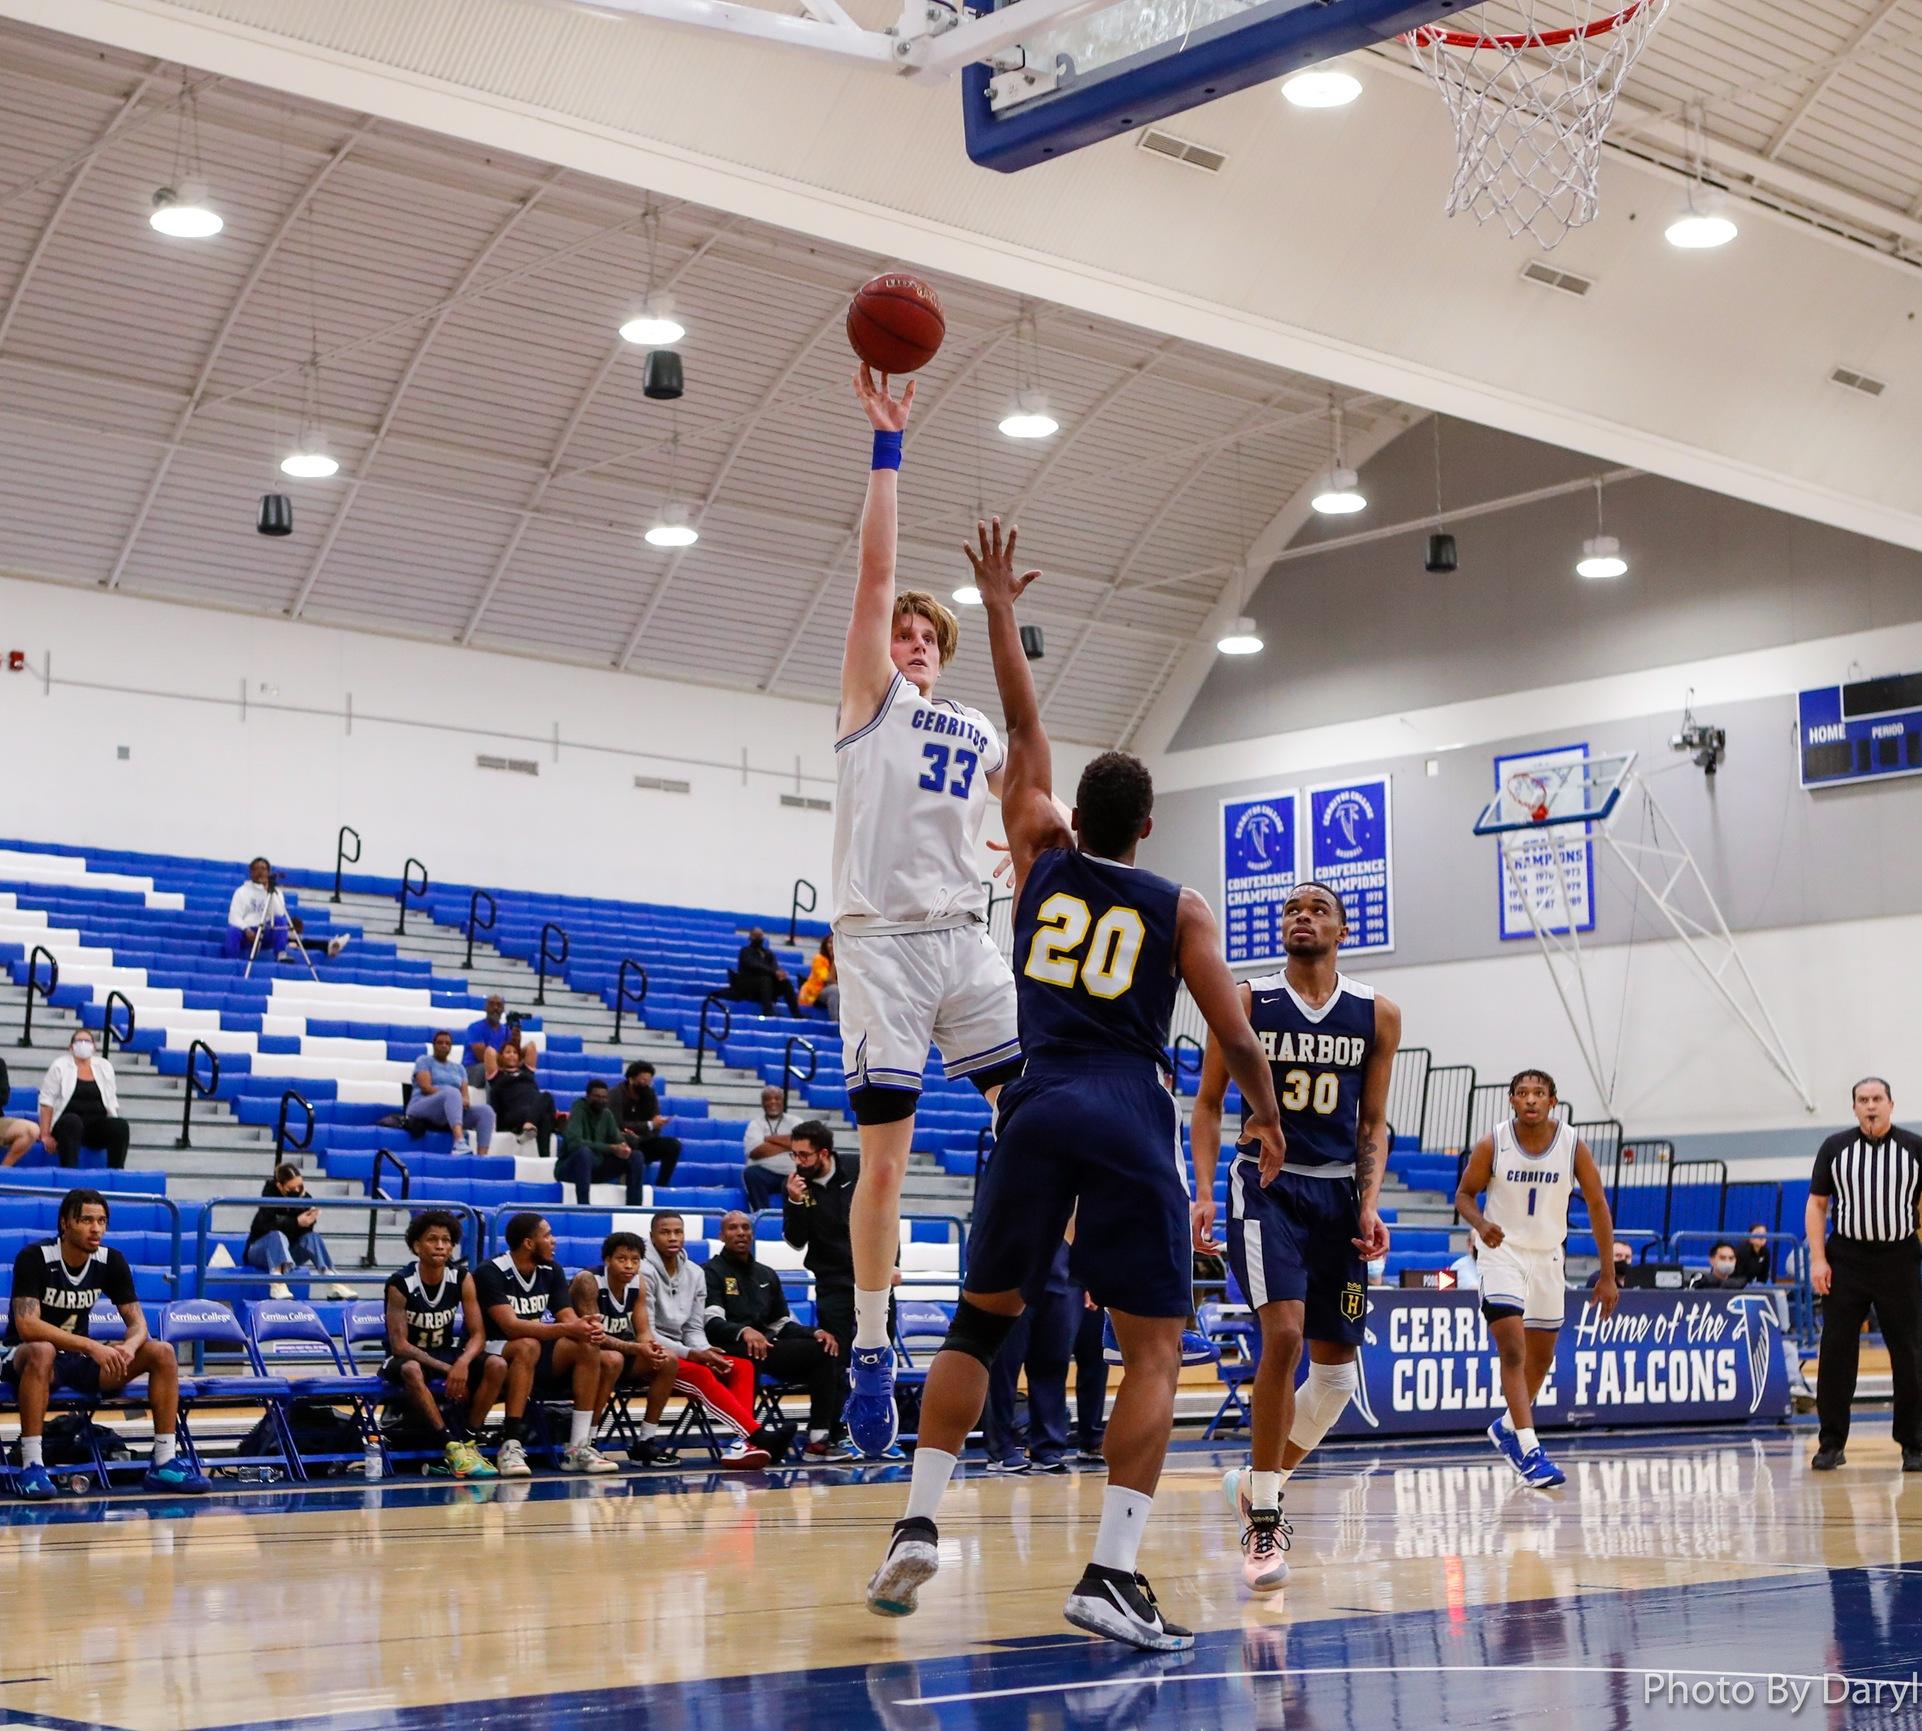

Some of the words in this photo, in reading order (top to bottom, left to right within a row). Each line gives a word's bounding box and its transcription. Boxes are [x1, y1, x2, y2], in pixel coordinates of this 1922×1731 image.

[911, 708, 989, 754] CERRITOS
[1808, 722, 1847, 744] HOME
[1871, 722, 1905, 739] PERIOD
[918, 742, 979, 800] 33
[1315, 858, 1385, 881] CONFERENCE
[1227, 872, 1294, 892] CONFERENCE
[1342, 893, 1360, 906] 1977
[1024, 892, 1146, 1000] 20
[1258, 1031, 1366, 1067] HARBOR
[1282, 1069, 1340, 1115] 30
[1506, 1169, 1560, 1184] CERRITOS
[1527, 1187, 1538, 1217] 1
[261, 1311, 289, 1322] Cerritos
[1347, 1295, 1360, 1315] H
[60, 1313, 79, 1335] 4
[169, 1311, 200, 1322] Cerritos
[201, 1311, 231, 1323] College
[1573, 1300, 1653, 1347] Home
[1654, 1301, 1684, 1345] of
[1685, 1301, 1729, 1345] the
[418, 1328, 444, 1348] 15
[1390, 1307, 1490, 1353] CERRI
[1393, 1356, 1558, 1412] COLLEE
[1574, 1349, 1737, 1406] FALCONS
